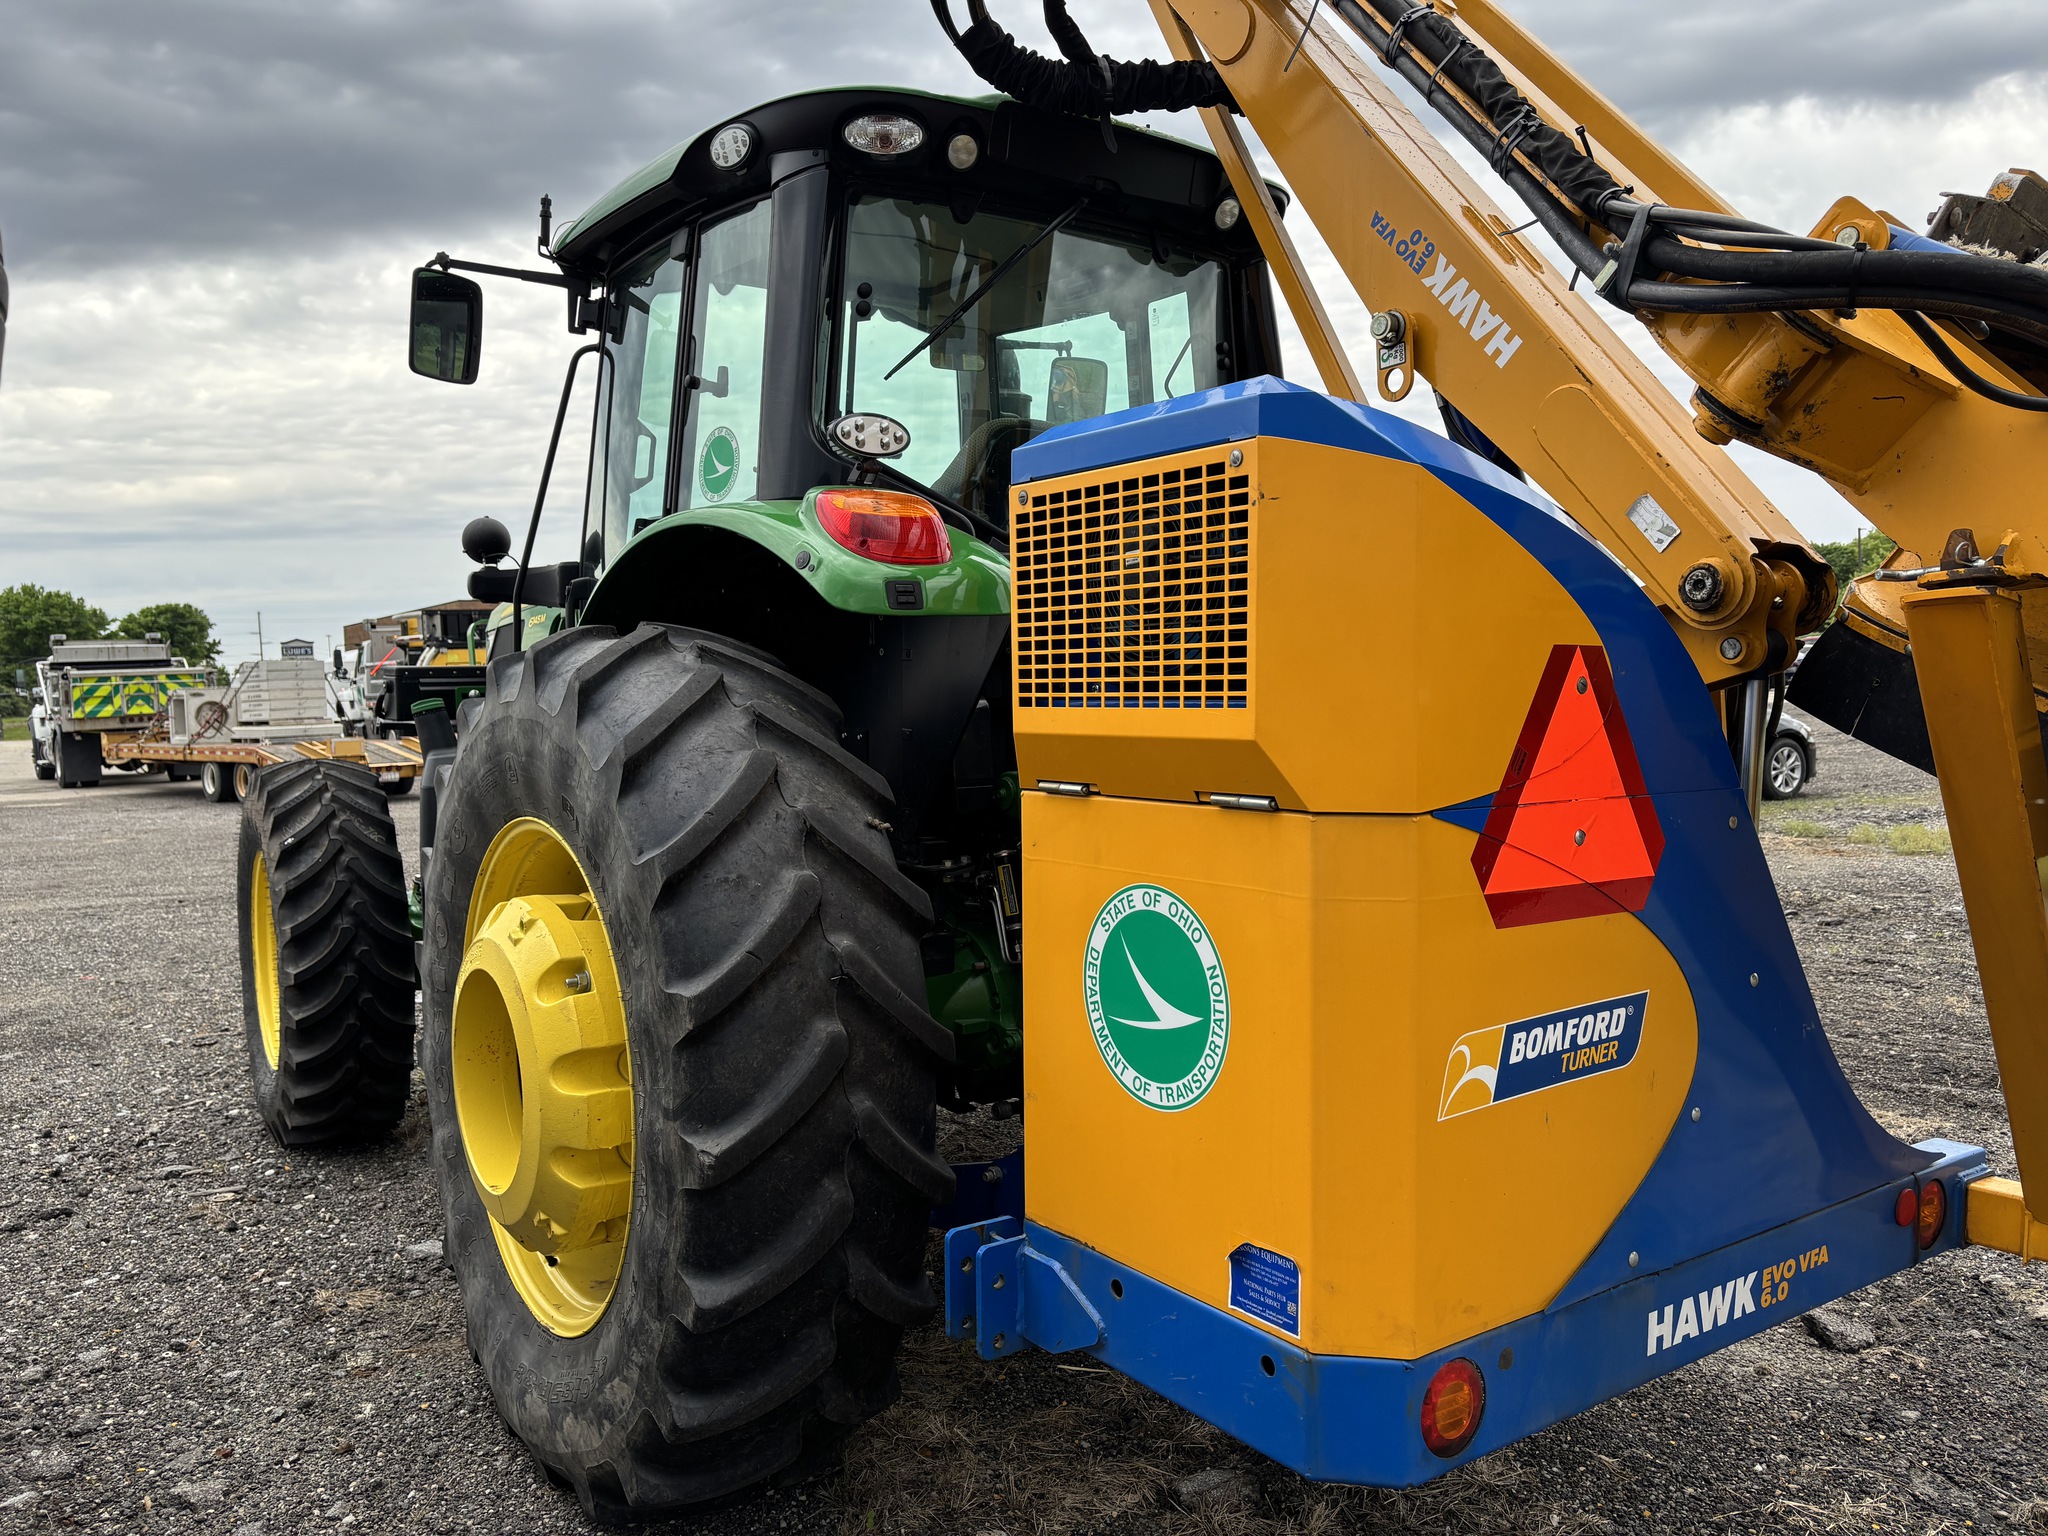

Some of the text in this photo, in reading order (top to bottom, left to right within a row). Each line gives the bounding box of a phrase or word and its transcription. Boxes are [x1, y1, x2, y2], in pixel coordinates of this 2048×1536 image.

[1410, 229, 1436, 259] 6.0
[1370, 210, 1523, 369] HAWK EVO VFA
[1100, 890, 1203, 944] STATE OF OHIO
[1087, 946, 1225, 1103] DEPARTMENT OF TRANSPORTATION
[1561, 1040, 1619, 1073] TURNER
[1261, 1250, 1294, 1271] EQUIPMENT
[1647, 1244, 1829, 1357] HAWK EVO VFA
[1760, 1281, 1789, 1309] 6.0
